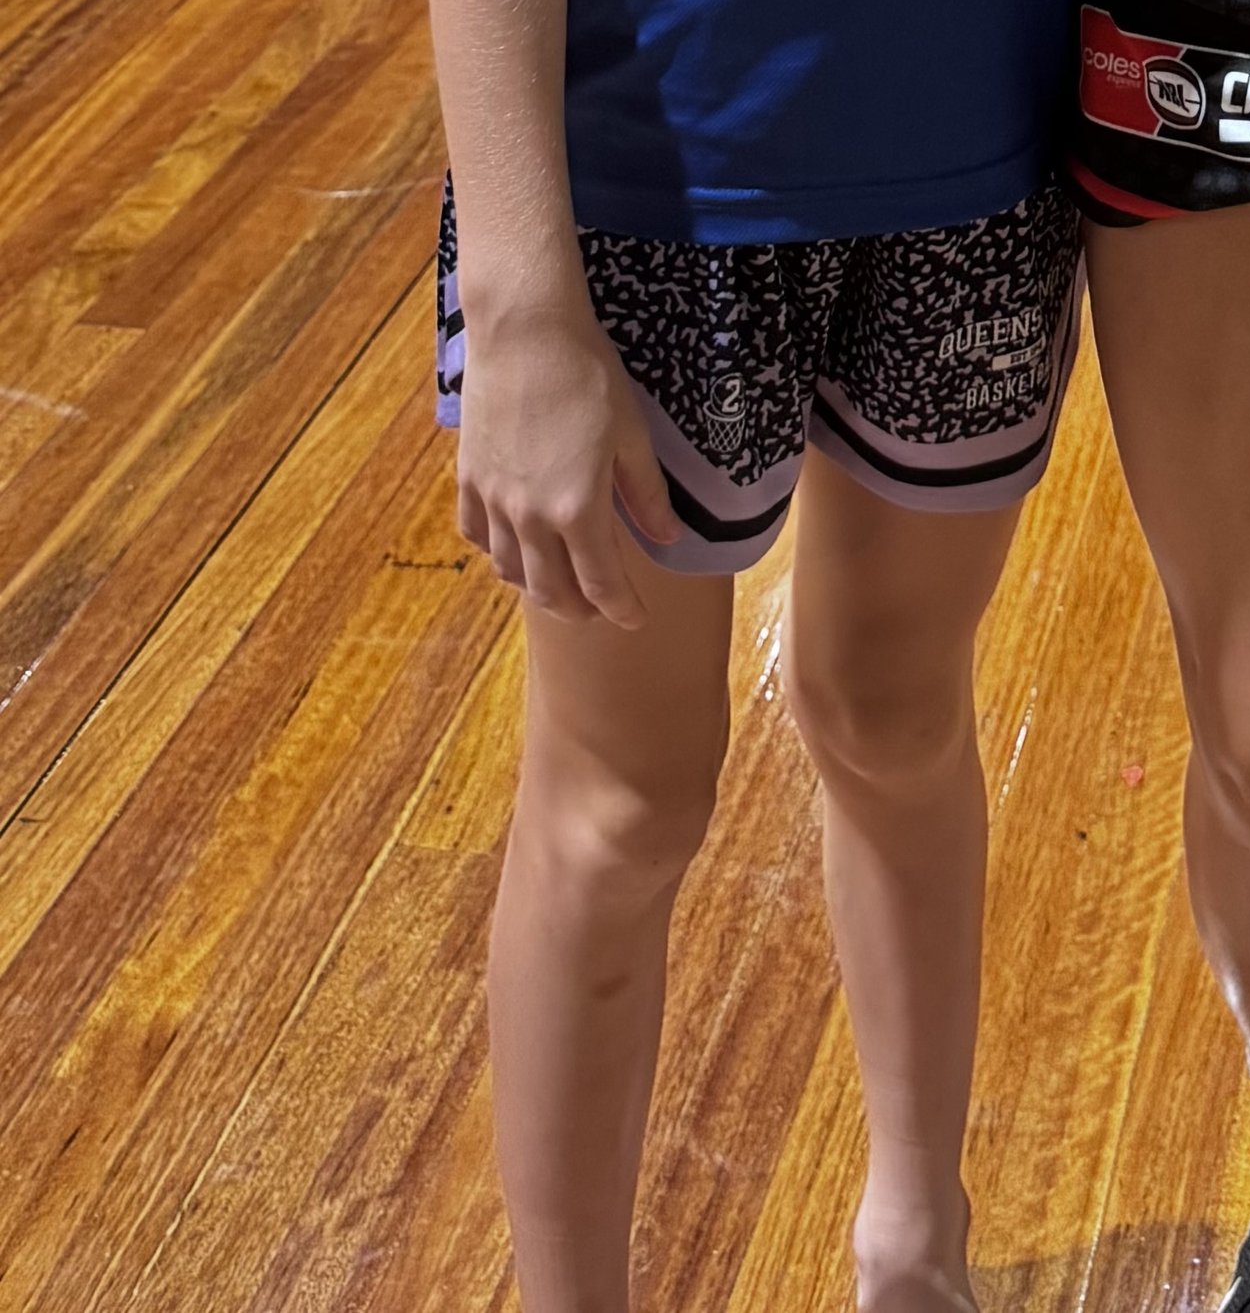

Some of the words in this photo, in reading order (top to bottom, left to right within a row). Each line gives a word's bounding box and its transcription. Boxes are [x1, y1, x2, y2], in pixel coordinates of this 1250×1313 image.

[1083, 47, 1141, 79] coles
[938, 305, 1043, 361] QUEENS
[721, 379, 741, 413] 2
